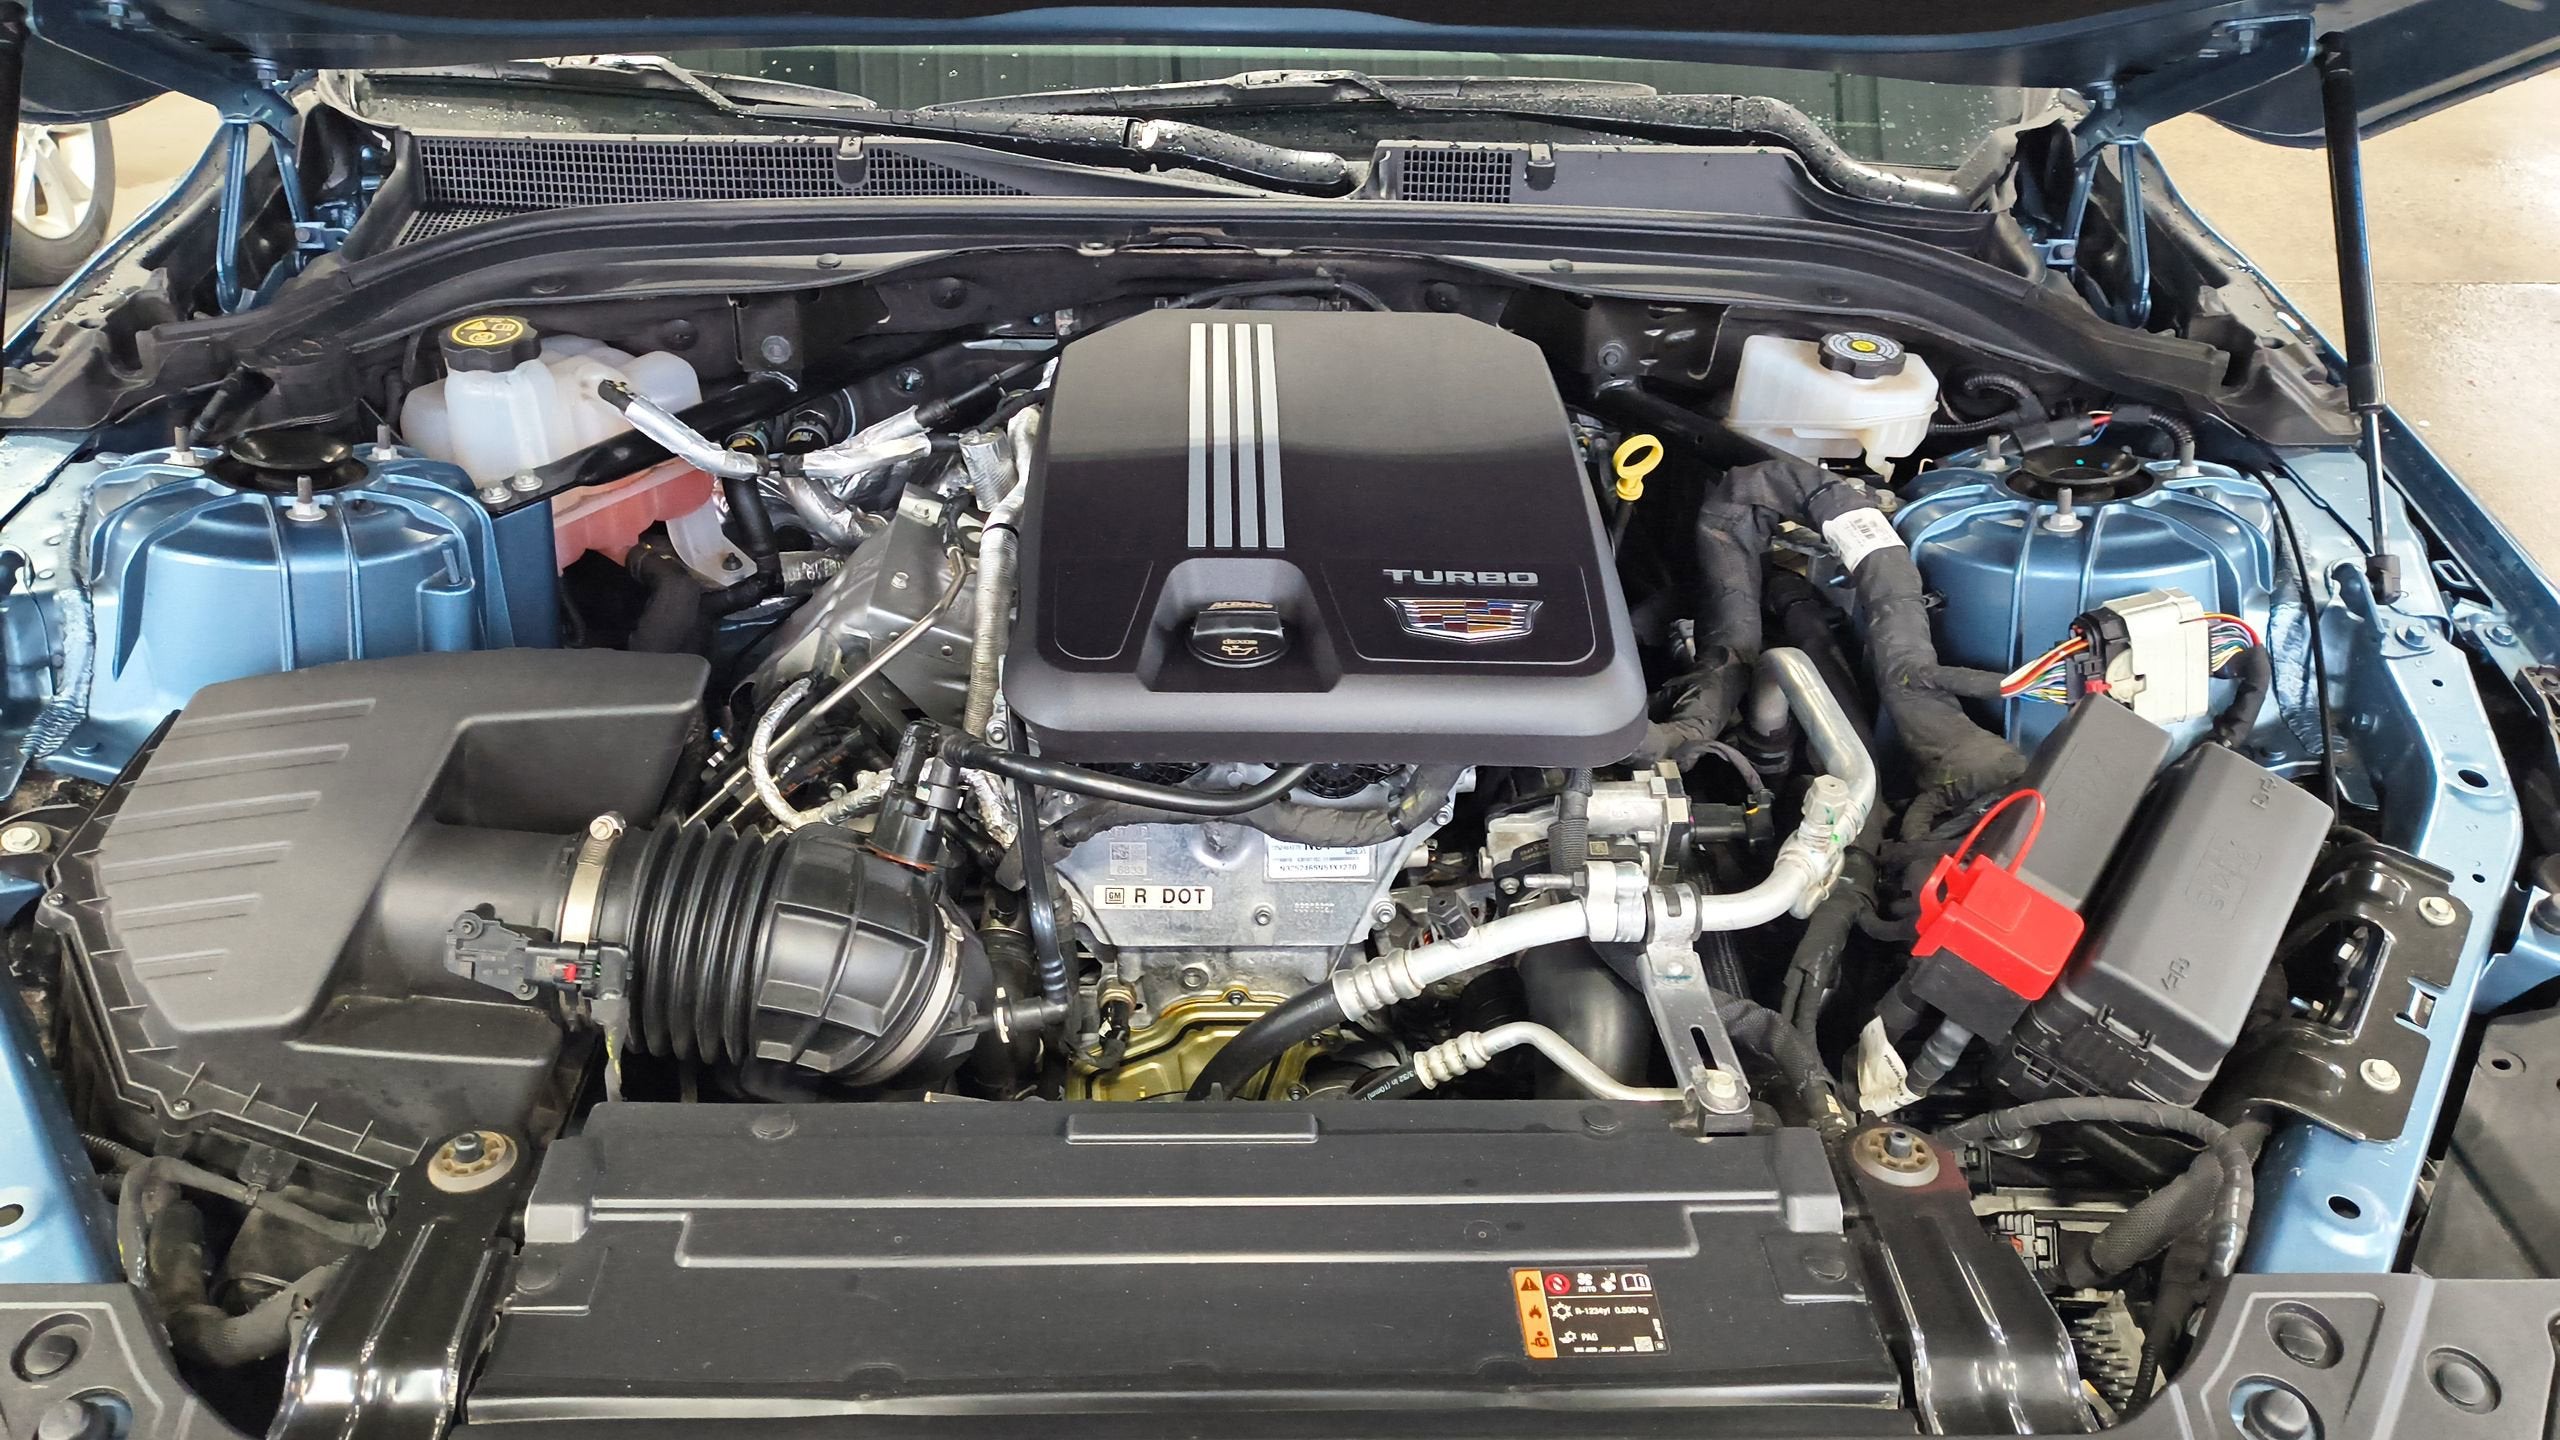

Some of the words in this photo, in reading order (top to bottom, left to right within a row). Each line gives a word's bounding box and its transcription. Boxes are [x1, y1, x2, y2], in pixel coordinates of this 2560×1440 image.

[1383, 568, 1540, 586] TURBO
[1135, 888, 1146, 903] R
[1163, 888, 1205, 904] DOT
[1638, 1306, 1649, 1315] kg
[1581, 1333, 1599, 1341] PAG
